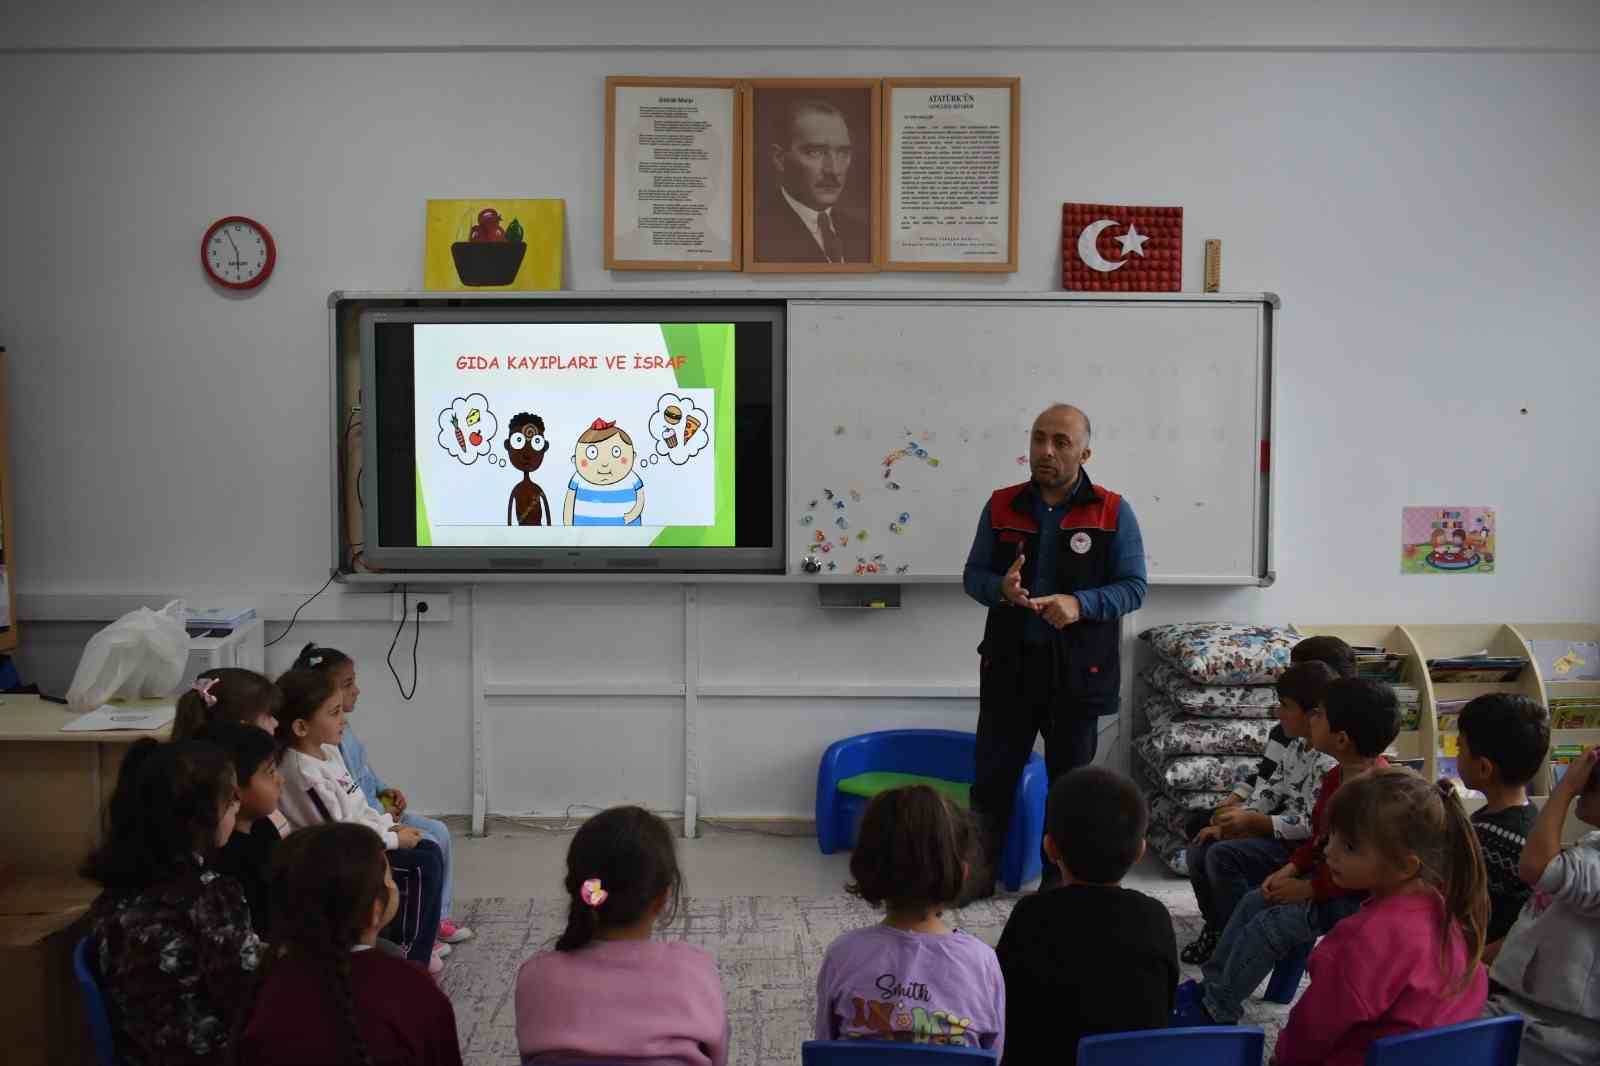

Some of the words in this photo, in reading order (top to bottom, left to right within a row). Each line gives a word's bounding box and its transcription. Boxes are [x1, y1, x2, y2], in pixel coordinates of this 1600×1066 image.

[456, 356, 500, 370] GIDA
[507, 355, 598, 370] KAYIPLARI
[605, 355, 627, 370] VE
[633, 352, 687, 370] İSRAF
[875, 974, 930, 1002] Smith
